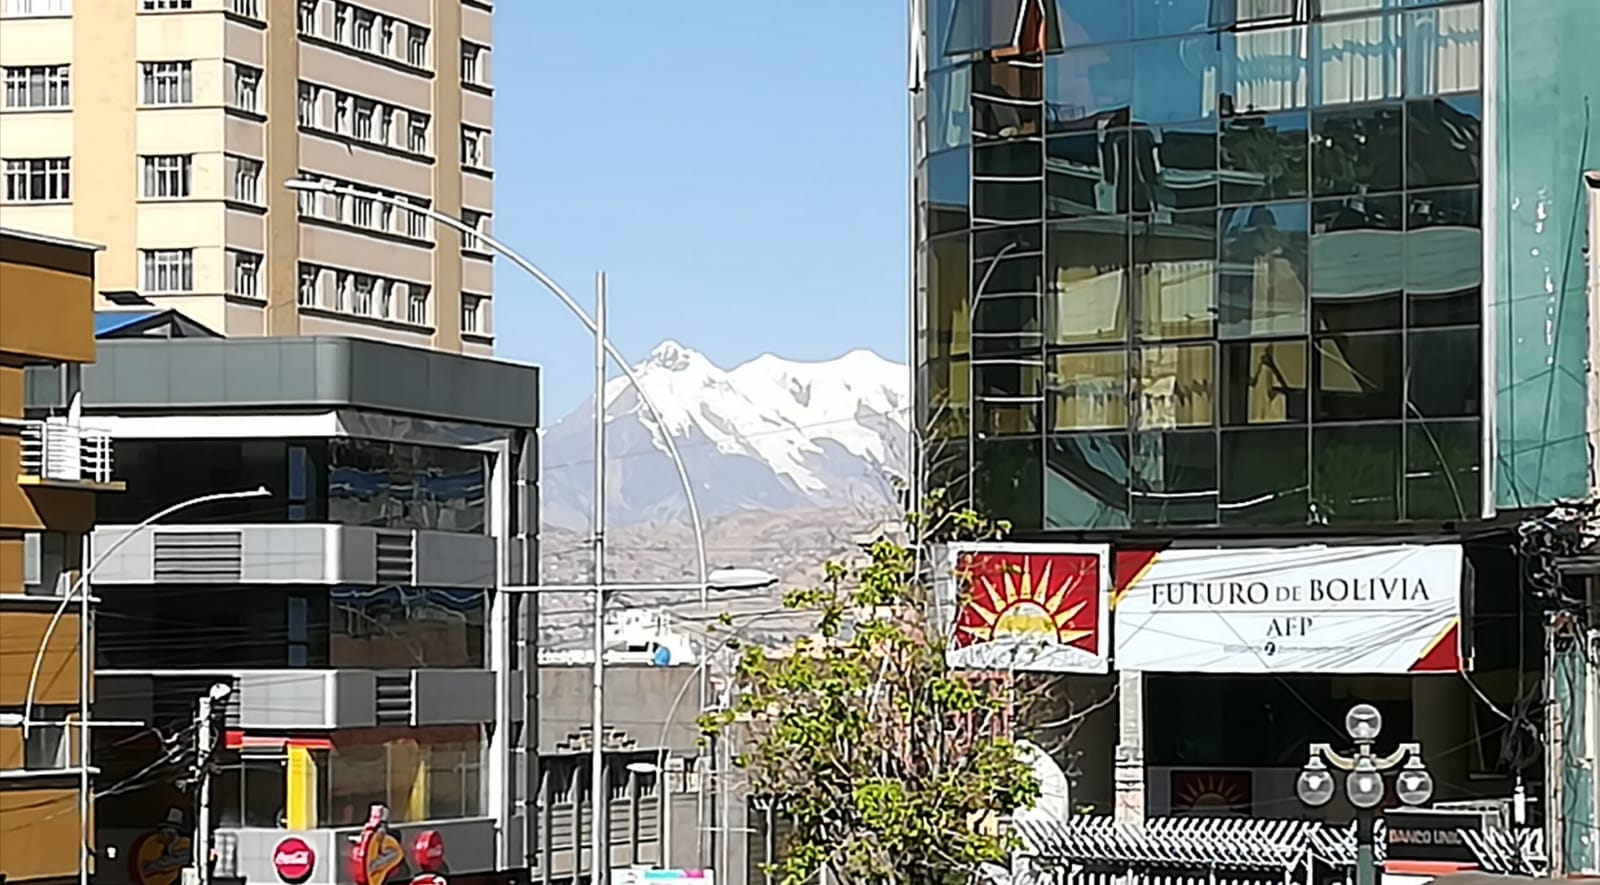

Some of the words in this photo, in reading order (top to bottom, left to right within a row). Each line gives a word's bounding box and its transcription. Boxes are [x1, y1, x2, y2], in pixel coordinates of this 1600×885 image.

[1152, 581, 1268, 605] FUTURO
[1276, 586, 1301, 602] DE
[1310, 577, 1430, 601] BOLIVIA
[1266, 617, 1313, 637] AFP
